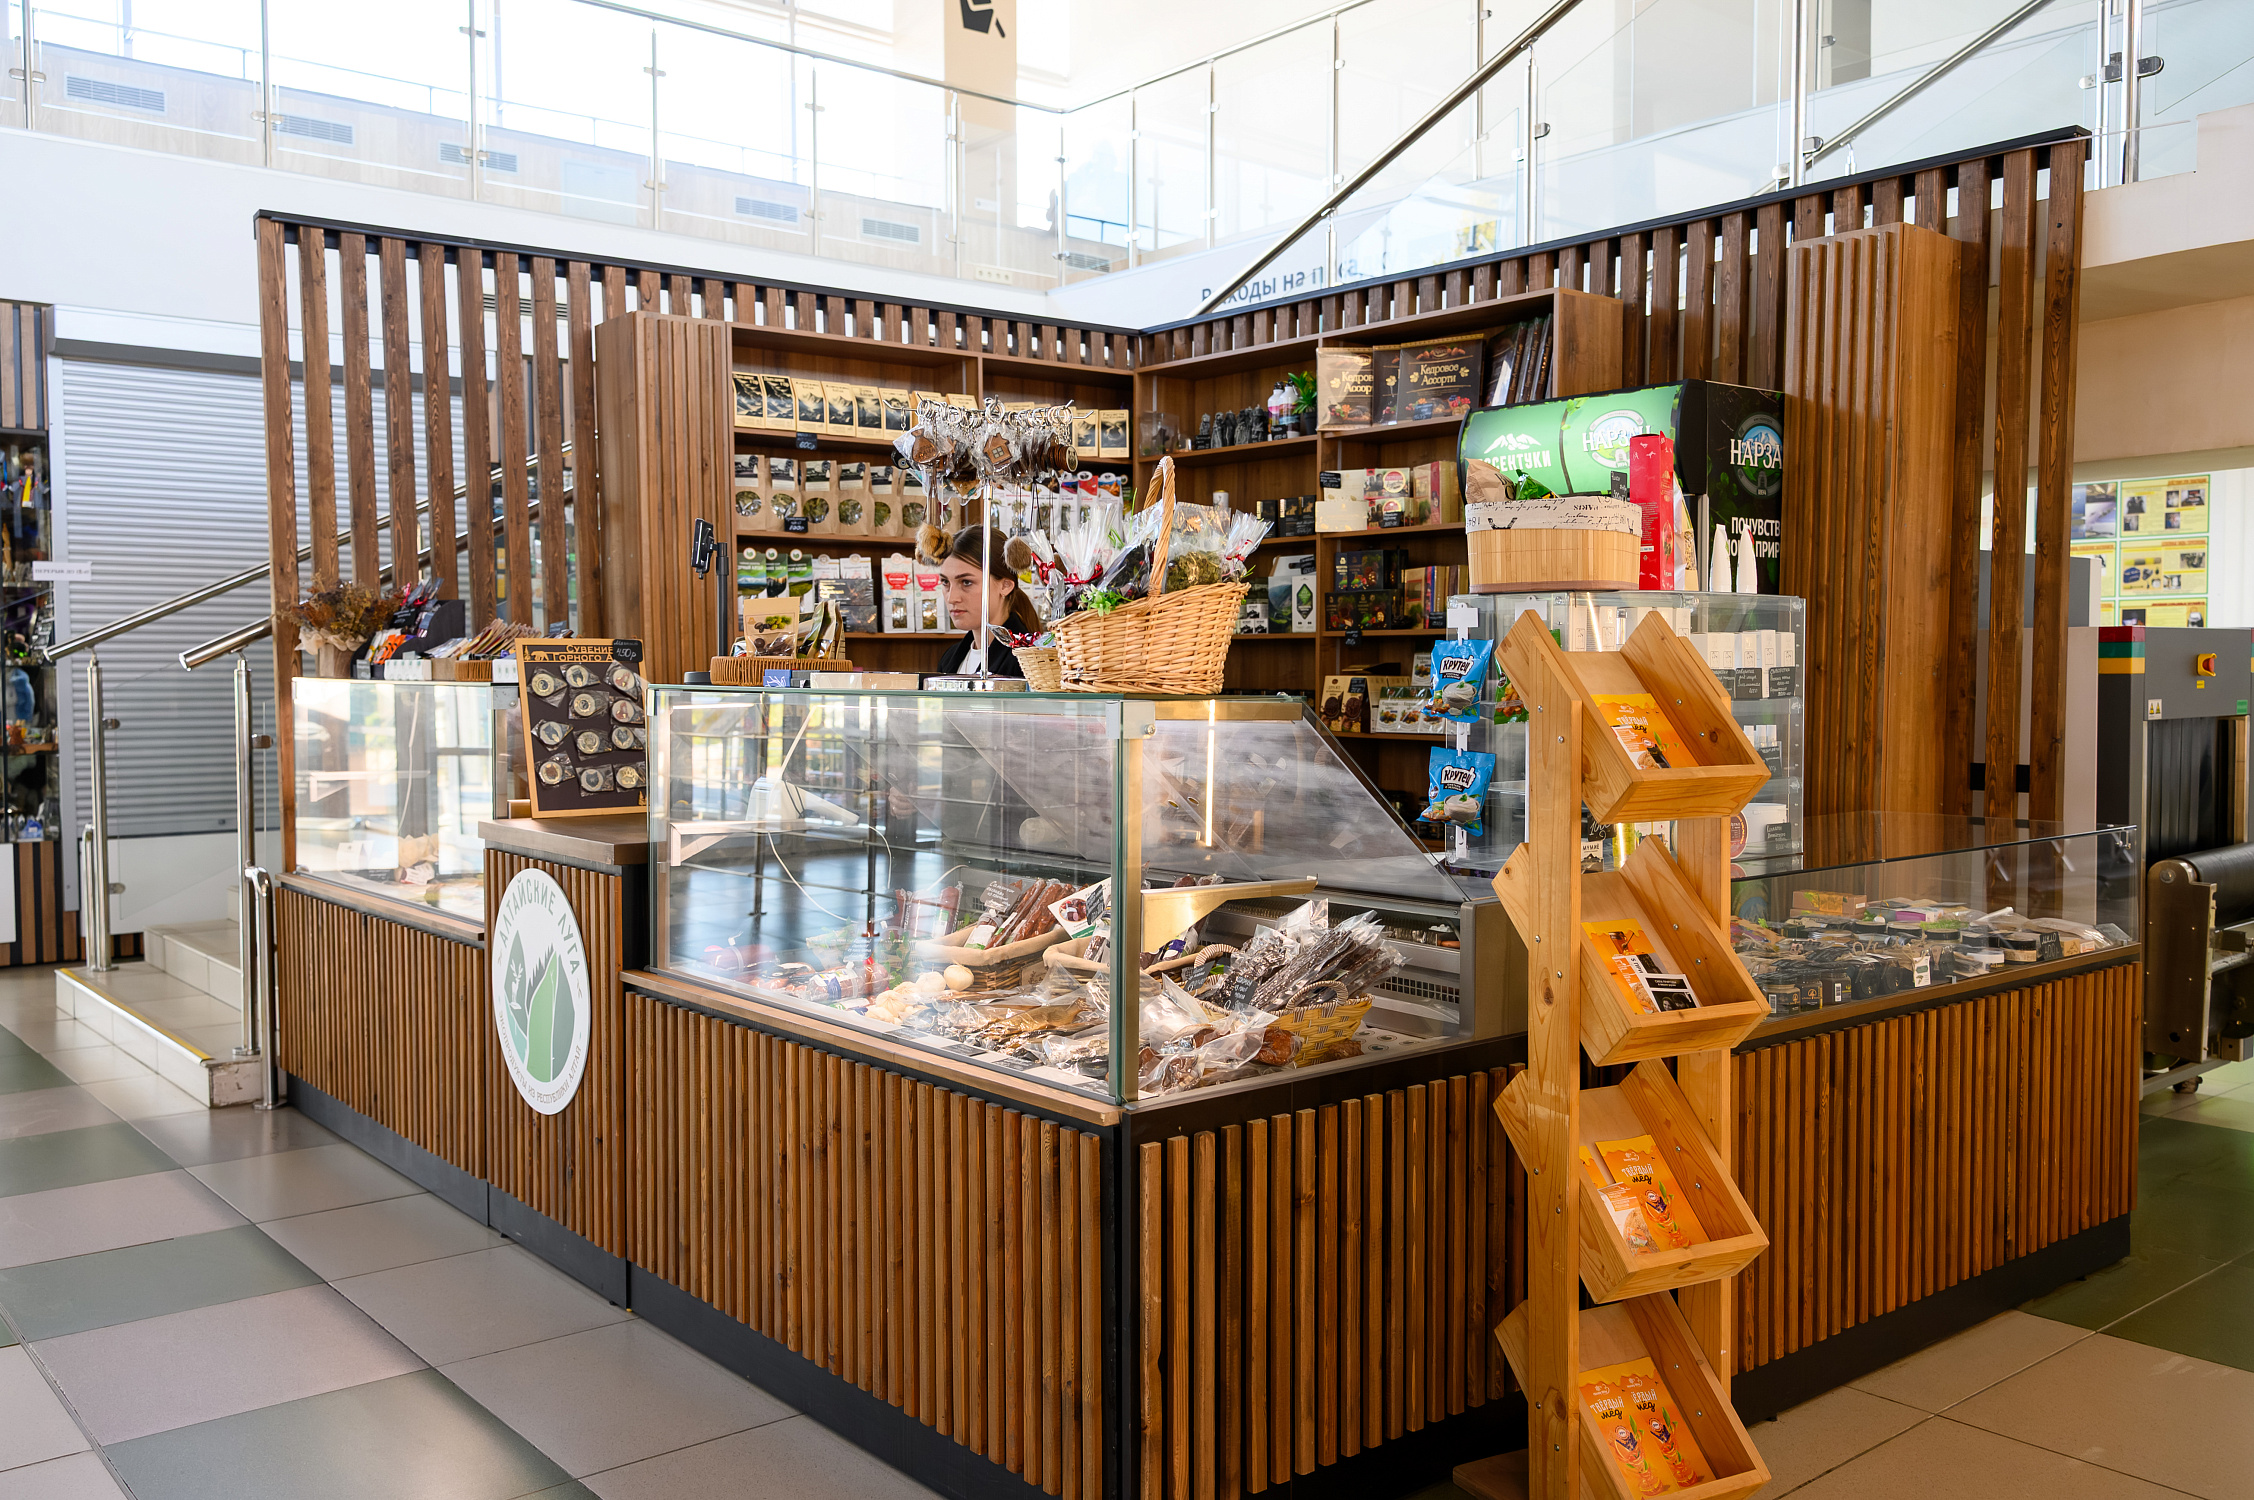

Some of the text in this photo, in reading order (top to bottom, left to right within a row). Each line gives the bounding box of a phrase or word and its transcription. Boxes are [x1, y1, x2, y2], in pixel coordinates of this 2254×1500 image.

[1283, 271, 1305, 291] на
[1420, 364, 1459, 376] Кедровое
[1421, 375, 1457, 387] Ассорти
[552, 653, 602, 661] ГОРНОГО
[616, 648, 637, 661] 450р
[1443, 658, 1471, 673] КРУТЕЦ
[1444, 769, 1472, 786] КРУТЕЦ
[499, 877, 580, 974] АЛТАЙСКИЕ ЛУГА
[499, 1010, 581, 1104] ЭКОПРОДУКТЫ ИЗ РЕСПУБЛИКИ АЛТАЙ
[1621, 1163, 1654, 1178] ТВЁРДЫЙ
[1632, 1174, 1652, 1185] мёд
[1590, 1396, 1624, 1414] ТВЁРДЫЙ
[1601, 1408, 1622, 1420] мёд
